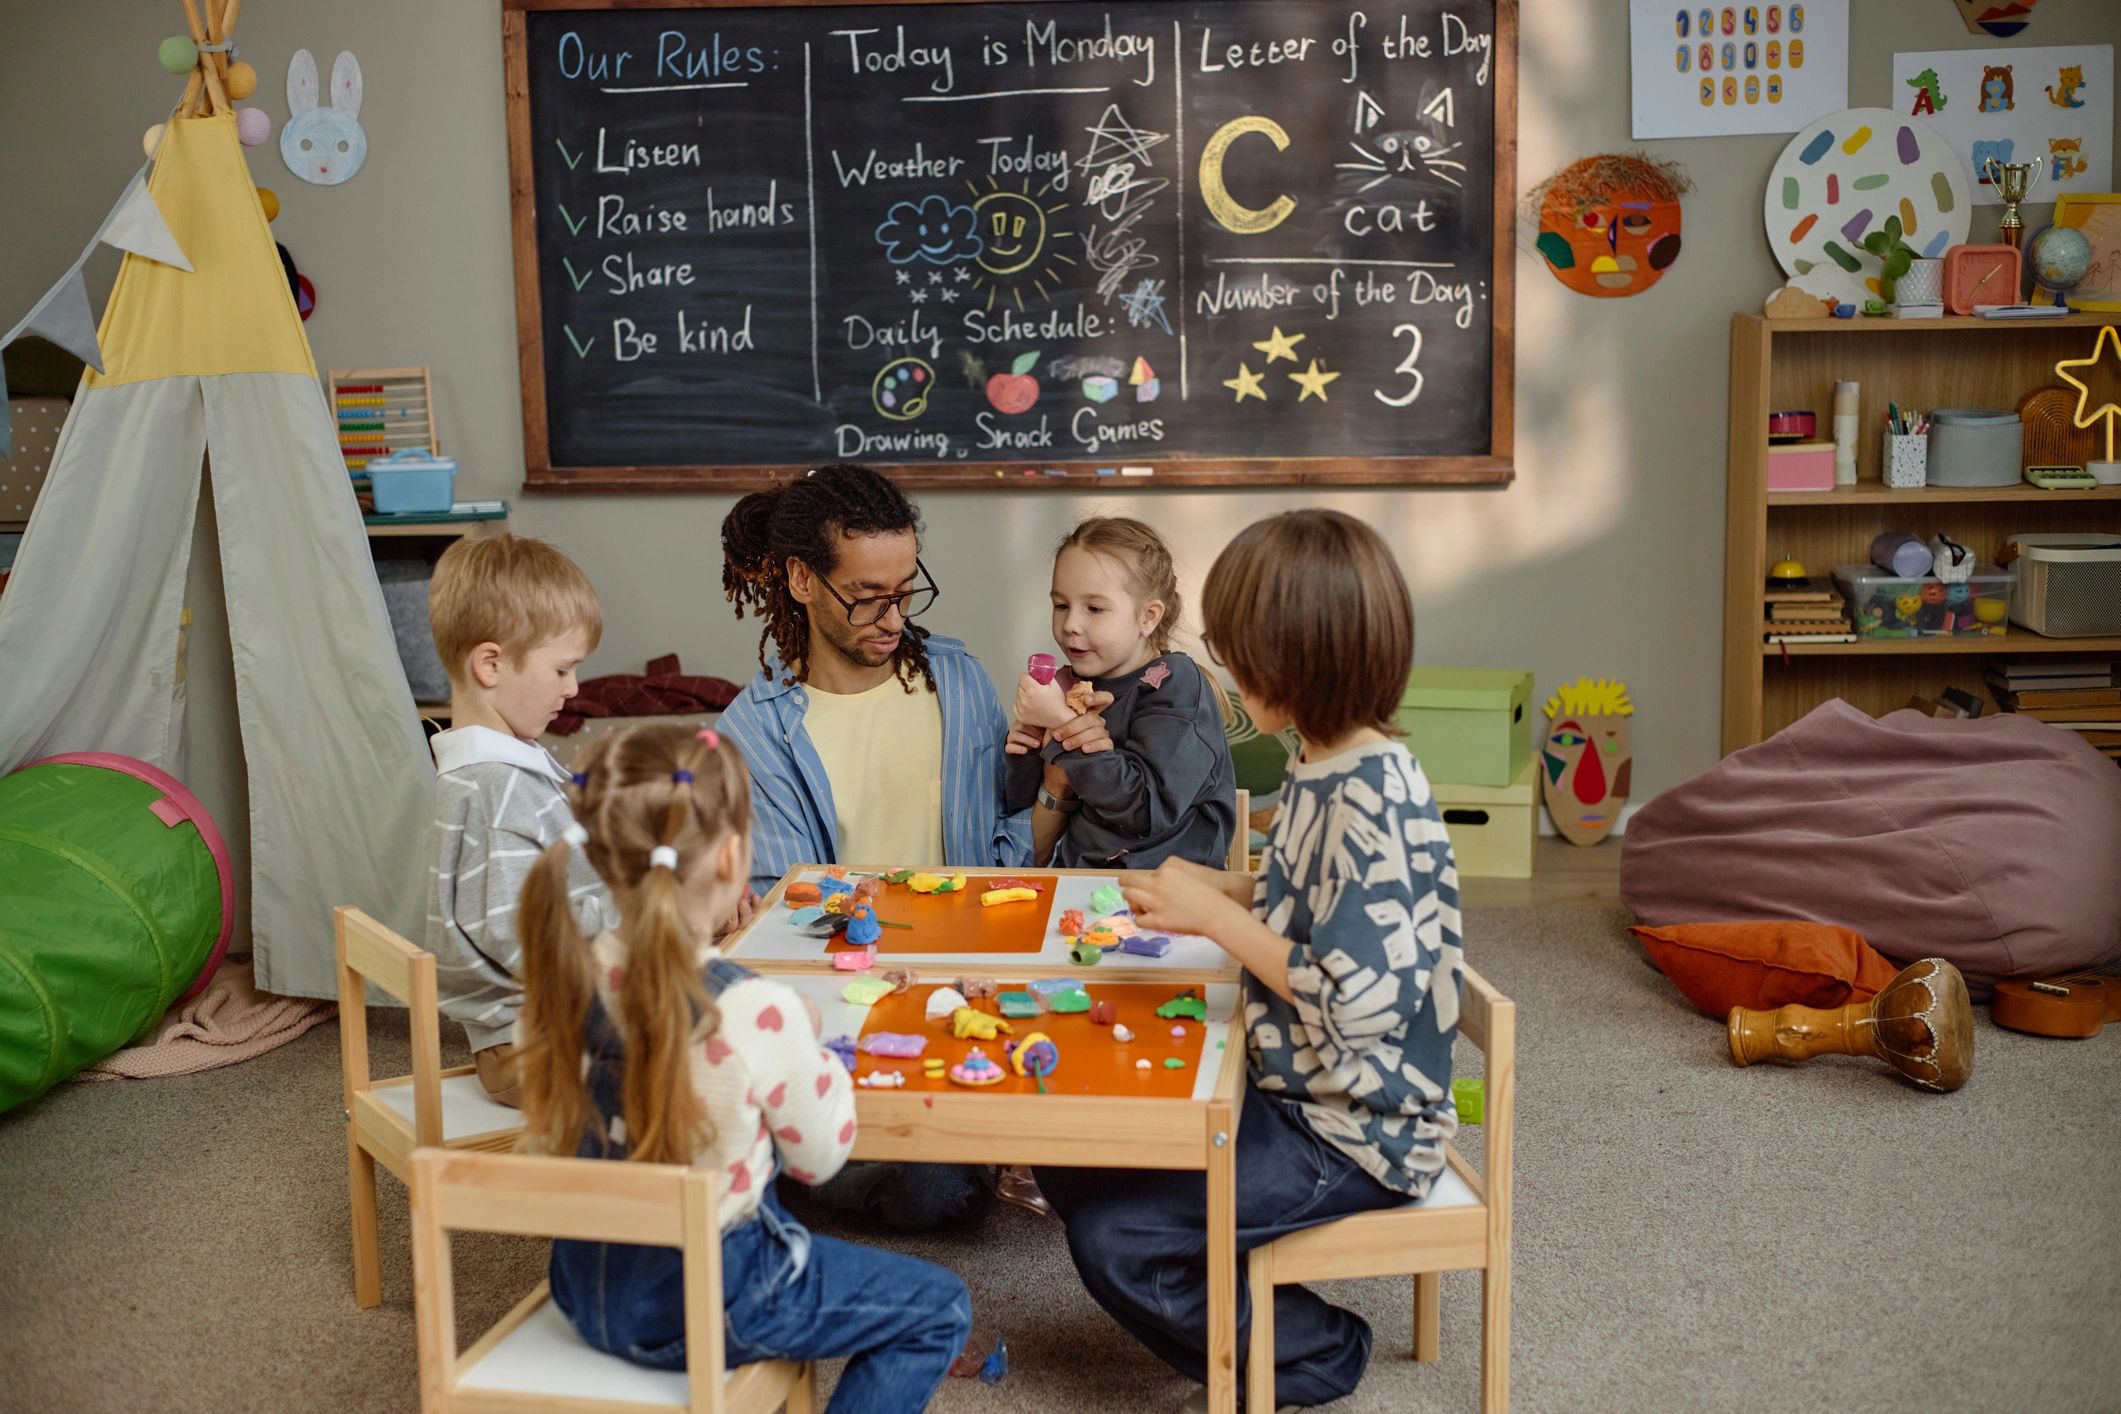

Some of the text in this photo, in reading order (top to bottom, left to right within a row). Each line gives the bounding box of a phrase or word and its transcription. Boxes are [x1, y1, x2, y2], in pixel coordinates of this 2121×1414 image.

[1200, 11, 1491, 86] Letter of the Day
[1676, 6, 1804, 38] 1 2 3 4 5 6
[559, 31, 781, 81] Our Rules:
[829, 13, 1155, 92] Today is Monday
[1676, 46, 1690, 72] 7
[1699, 44, 1713, 72] 8
[1721, 43, 1736, 70] 9
[1744, 42, 1758, 70] 0
[1911, 88, 1935, 116] A
[597, 128, 702, 175] Listen
[832, 134, 1071, 192] Weather Today
[1199, 115, 1297, 234] C
[598, 179, 796, 240] Raise hands
[1344, 200, 1437, 236] cat
[602, 252, 697, 295] Share
[1197, 268, 1488, 329] Number of the Day:
[613, 304, 755, 362] Be kind
[843, 303, 1116, 359] Daily Schedule:
[1374, 323, 1425, 407] 3
[976, 411, 1053, 450] Snack
[1072, 407, 1165, 453] Games
